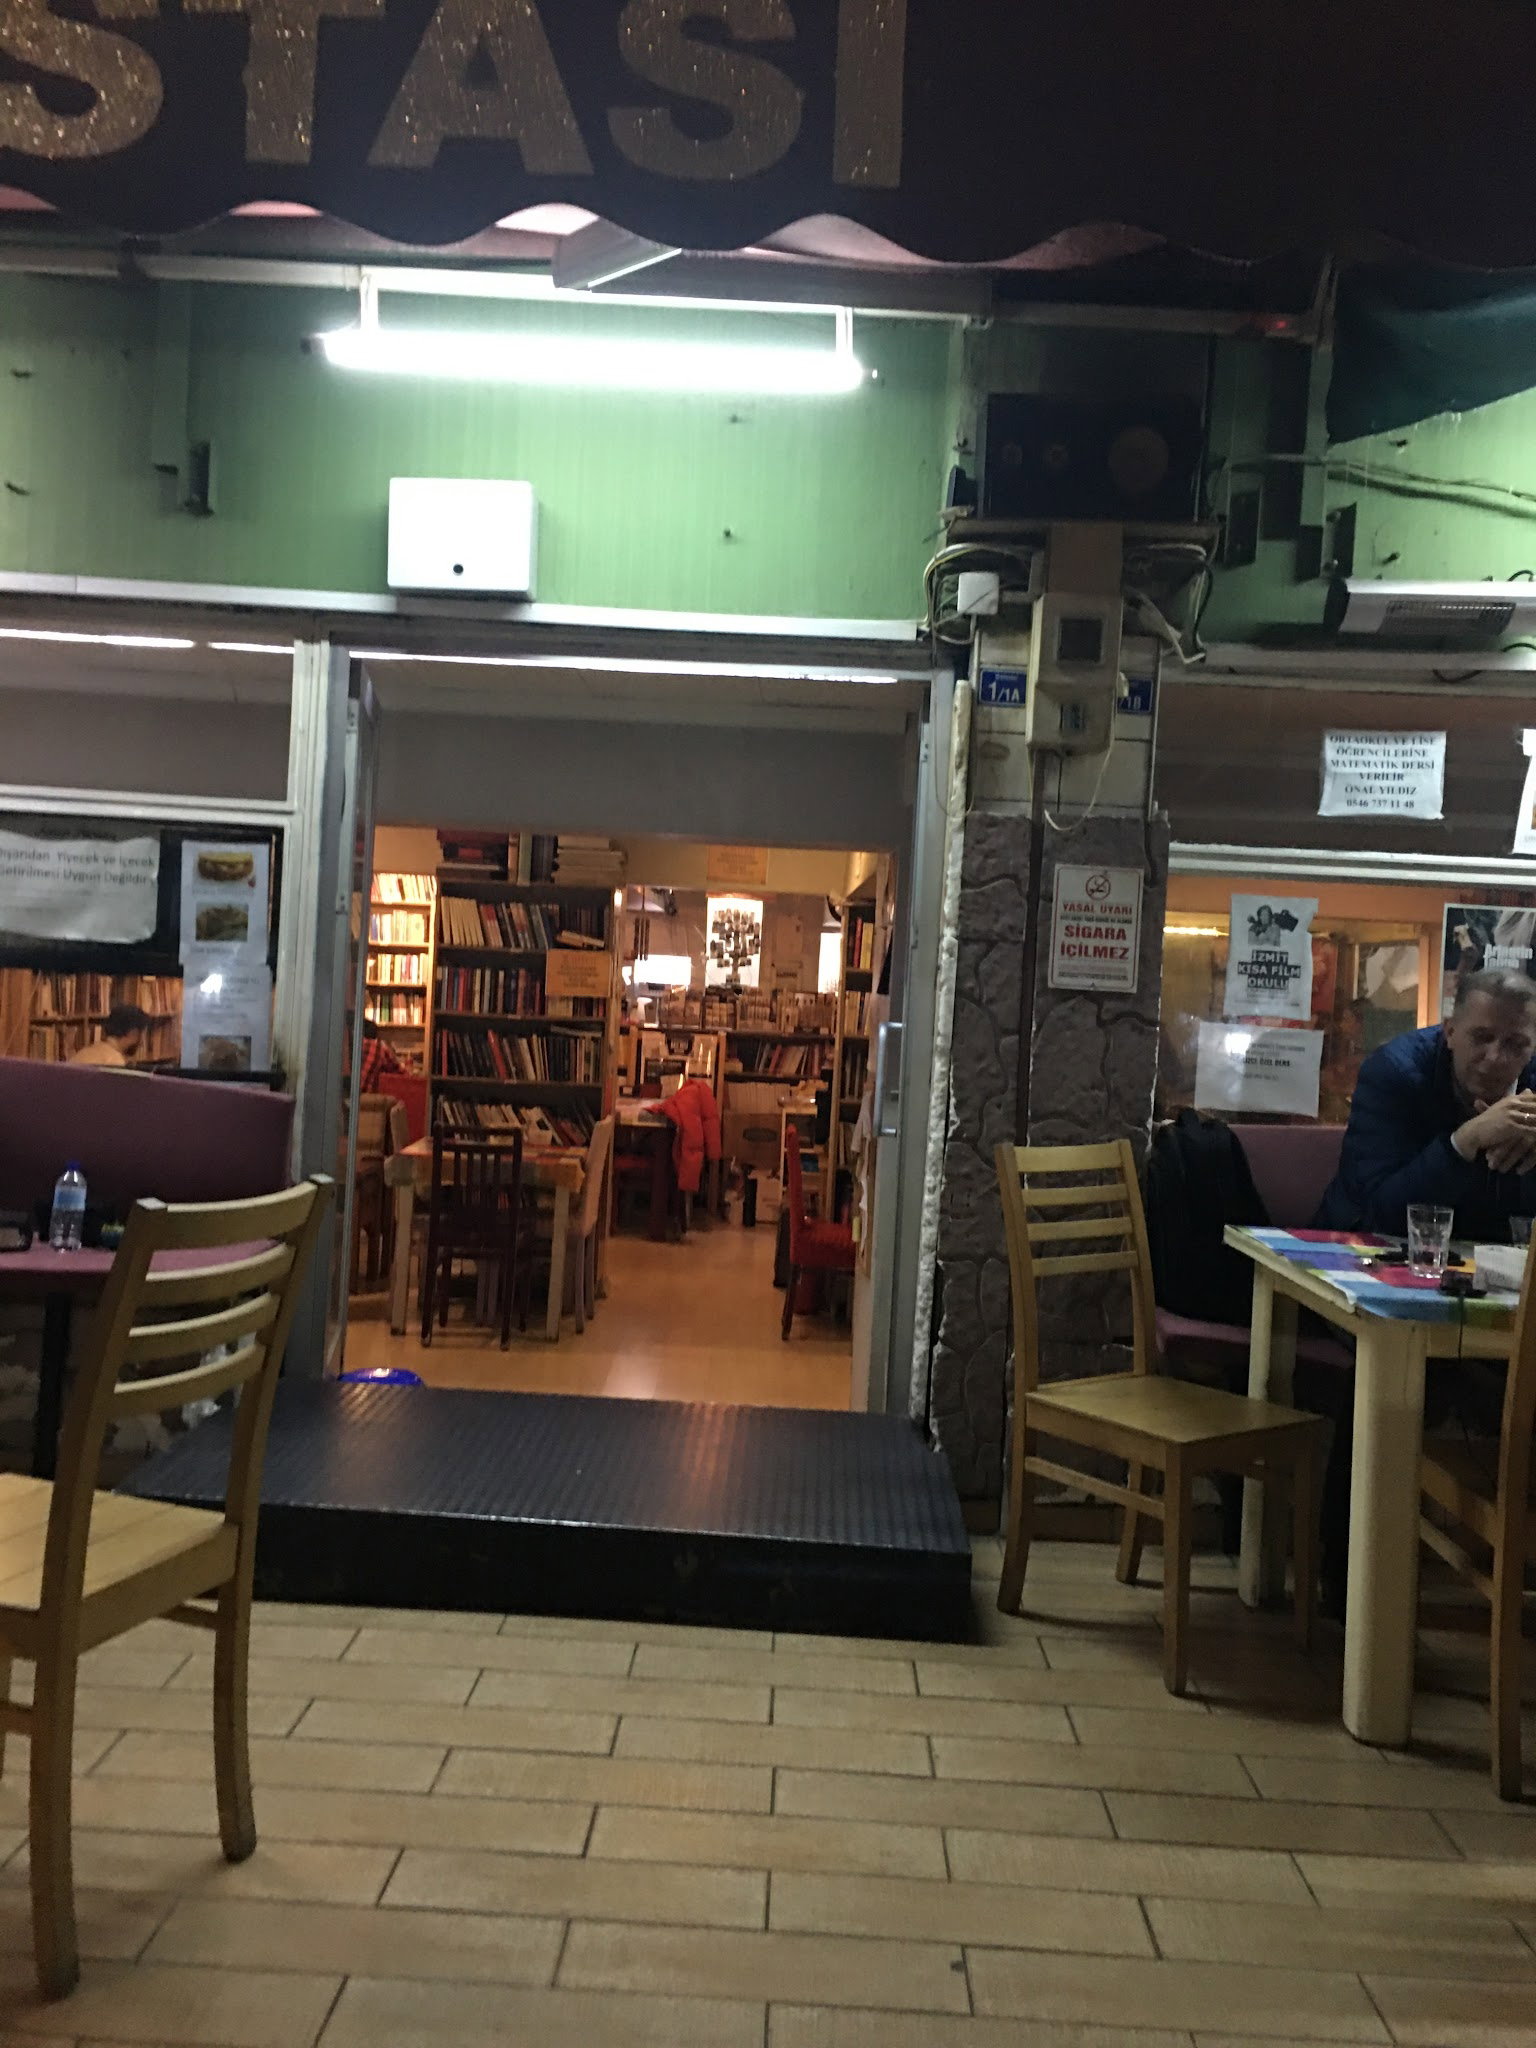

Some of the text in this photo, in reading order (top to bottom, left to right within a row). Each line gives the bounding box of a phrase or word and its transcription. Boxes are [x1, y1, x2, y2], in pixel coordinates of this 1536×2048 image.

[1330, 735, 1388, 745] ORTAOKUL
[1393, 736, 1407, 745] VE
[1336, 745, 1427, 757] ÖĞRENCİLERİNE
[1331, 759, 1435, 770] MATEMATİK DERSİ
[1359, 771, 1405, 781] VERİLİR
[1379, 785, 1417, 795] YILDIZ
[1346, 799, 1369, 808] 0546
[1391, 799, 1400, 808] 11
[1403, 800, 1415, 809] 48
[103, 855, 116, 864] ve
[64, 867, 101, 883] Uygun
[1063, 903, 1133, 916] YASAL UYARI
[1064, 922, 1127, 941] SİGARA
[1060, 941, 1130, 960] İÇİLMEZ
[1252, 950, 1288, 964] İZMİT
[1238, 962, 1301, 978] KISA FİLM
[1248, 977, 1288, 989] OKULU
